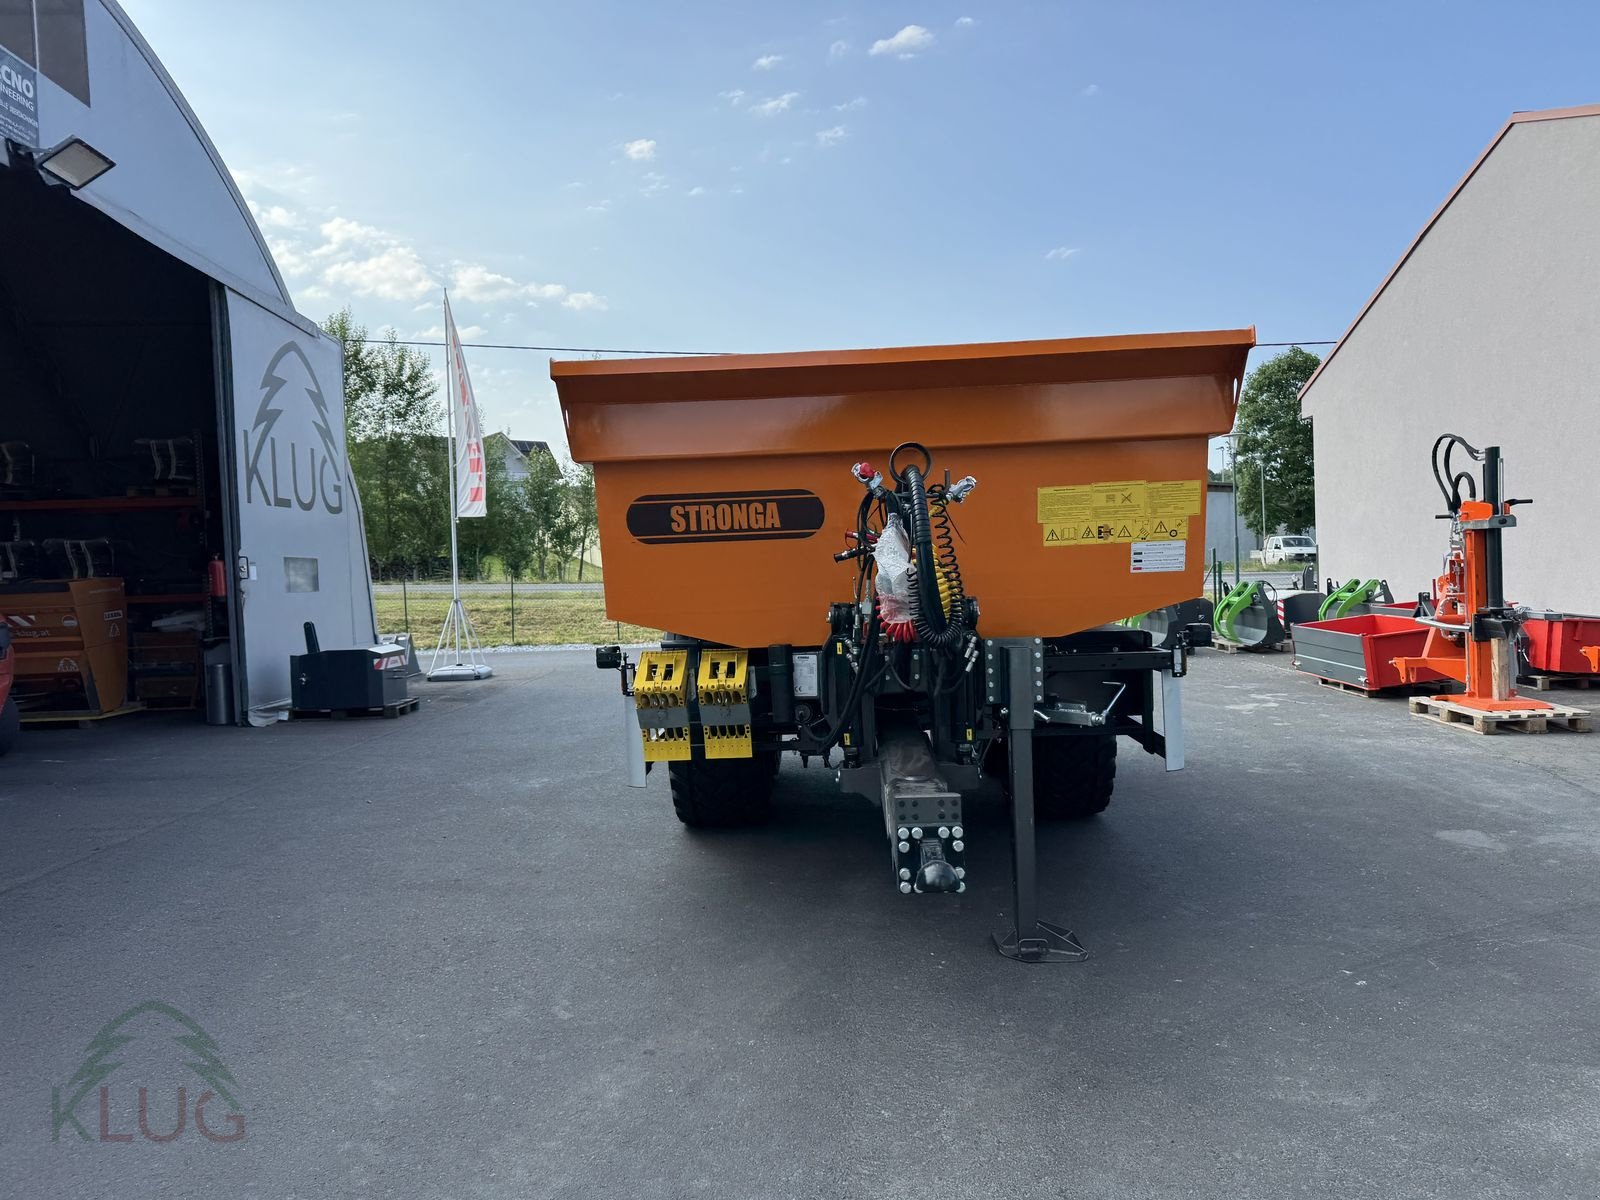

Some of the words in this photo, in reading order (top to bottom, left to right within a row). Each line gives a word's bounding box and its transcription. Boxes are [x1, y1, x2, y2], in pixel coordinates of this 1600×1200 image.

[0, 65, 34, 98] CNO
[243, 429, 343, 515] KLUG
[670, 502, 781, 533] STRONGA
